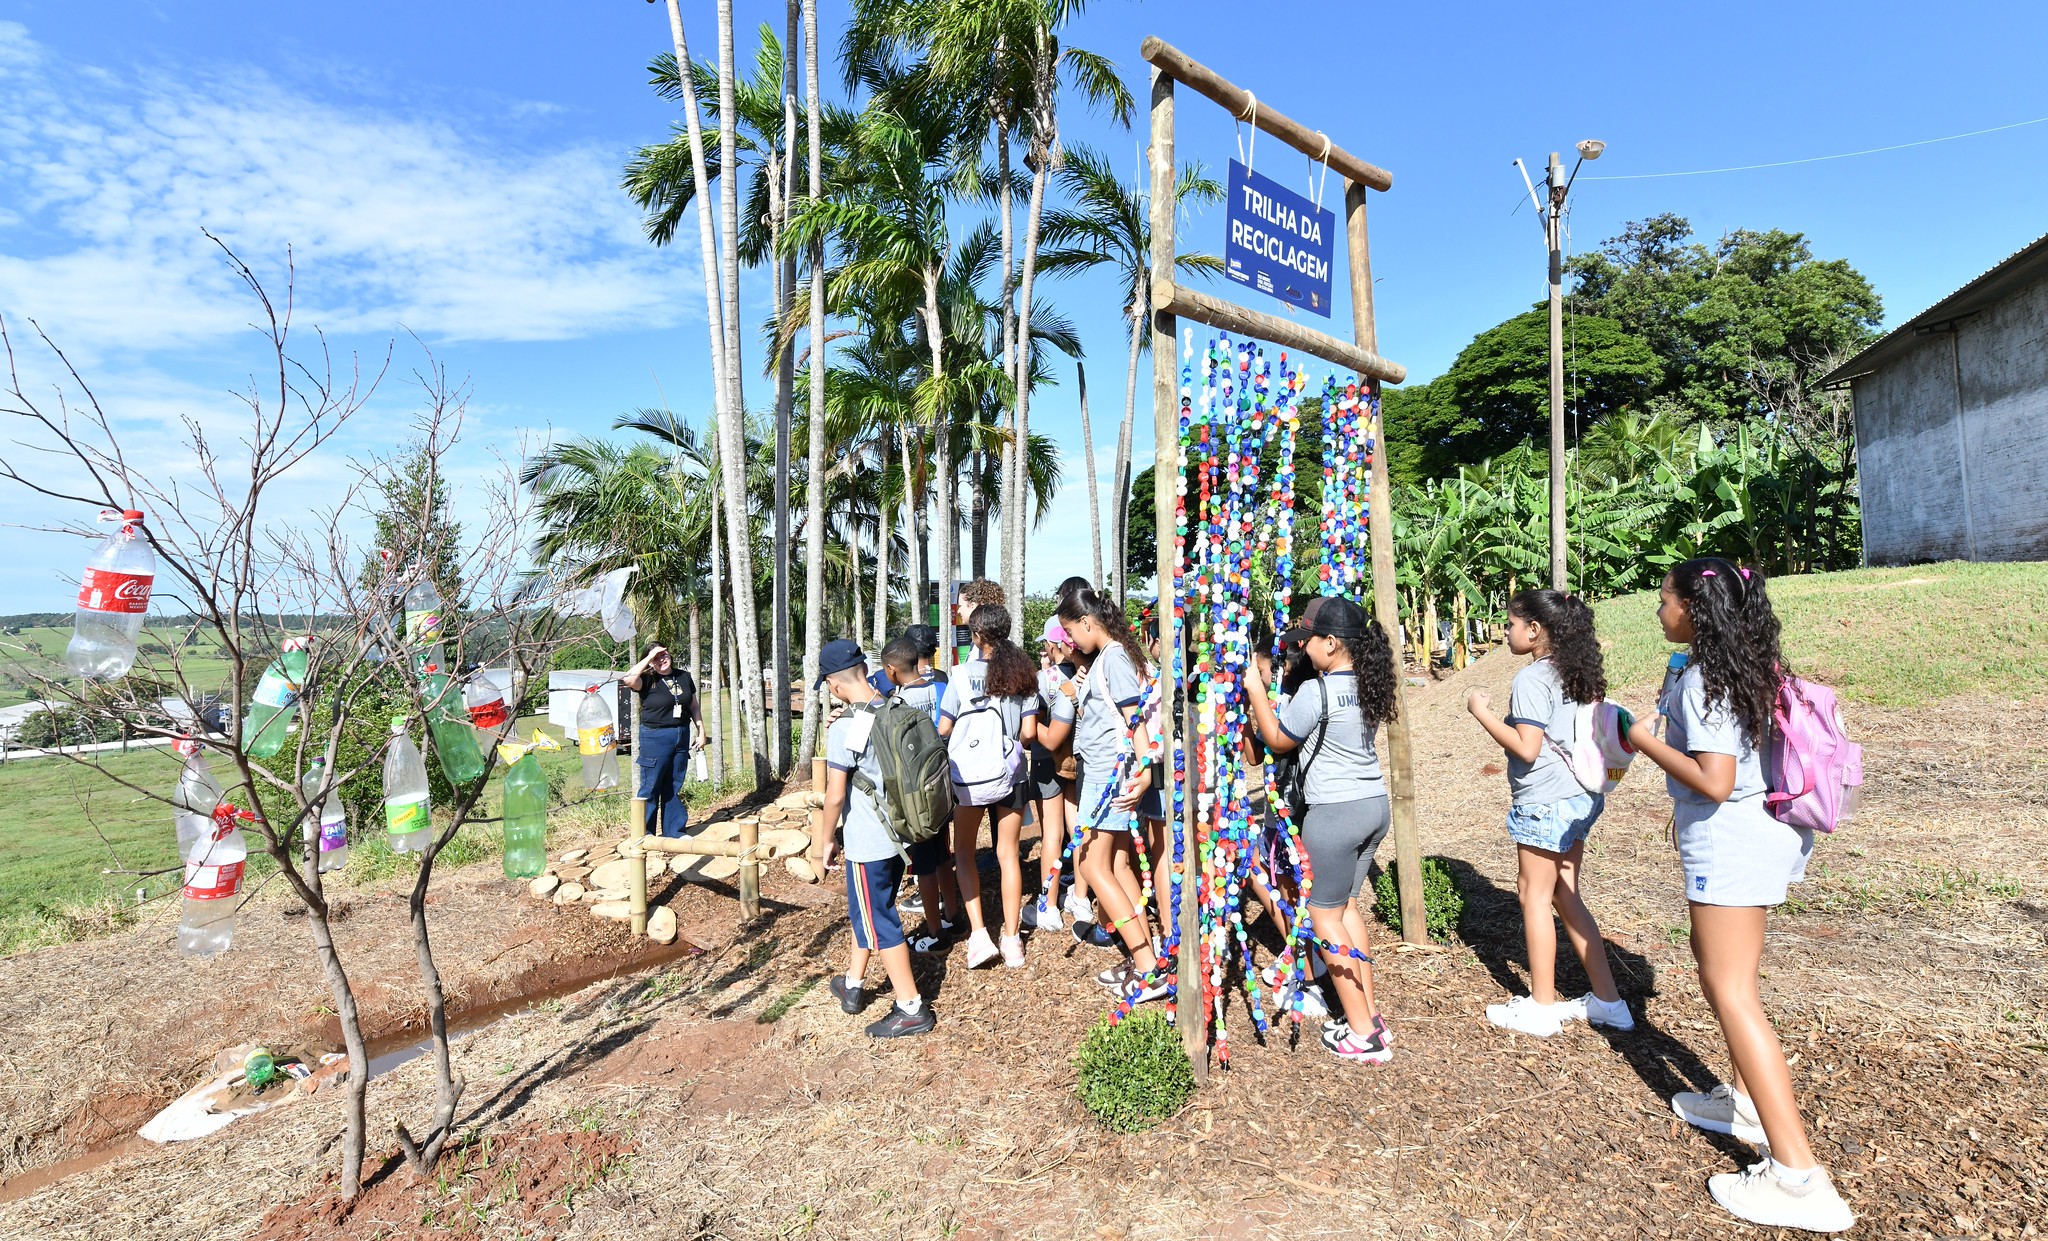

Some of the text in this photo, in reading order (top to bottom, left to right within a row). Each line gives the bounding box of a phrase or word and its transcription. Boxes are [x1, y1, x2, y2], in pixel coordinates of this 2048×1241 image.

[1242, 185, 1322, 246] TRILHA DA
[1232, 218, 1328, 283] RECICLAGEM
